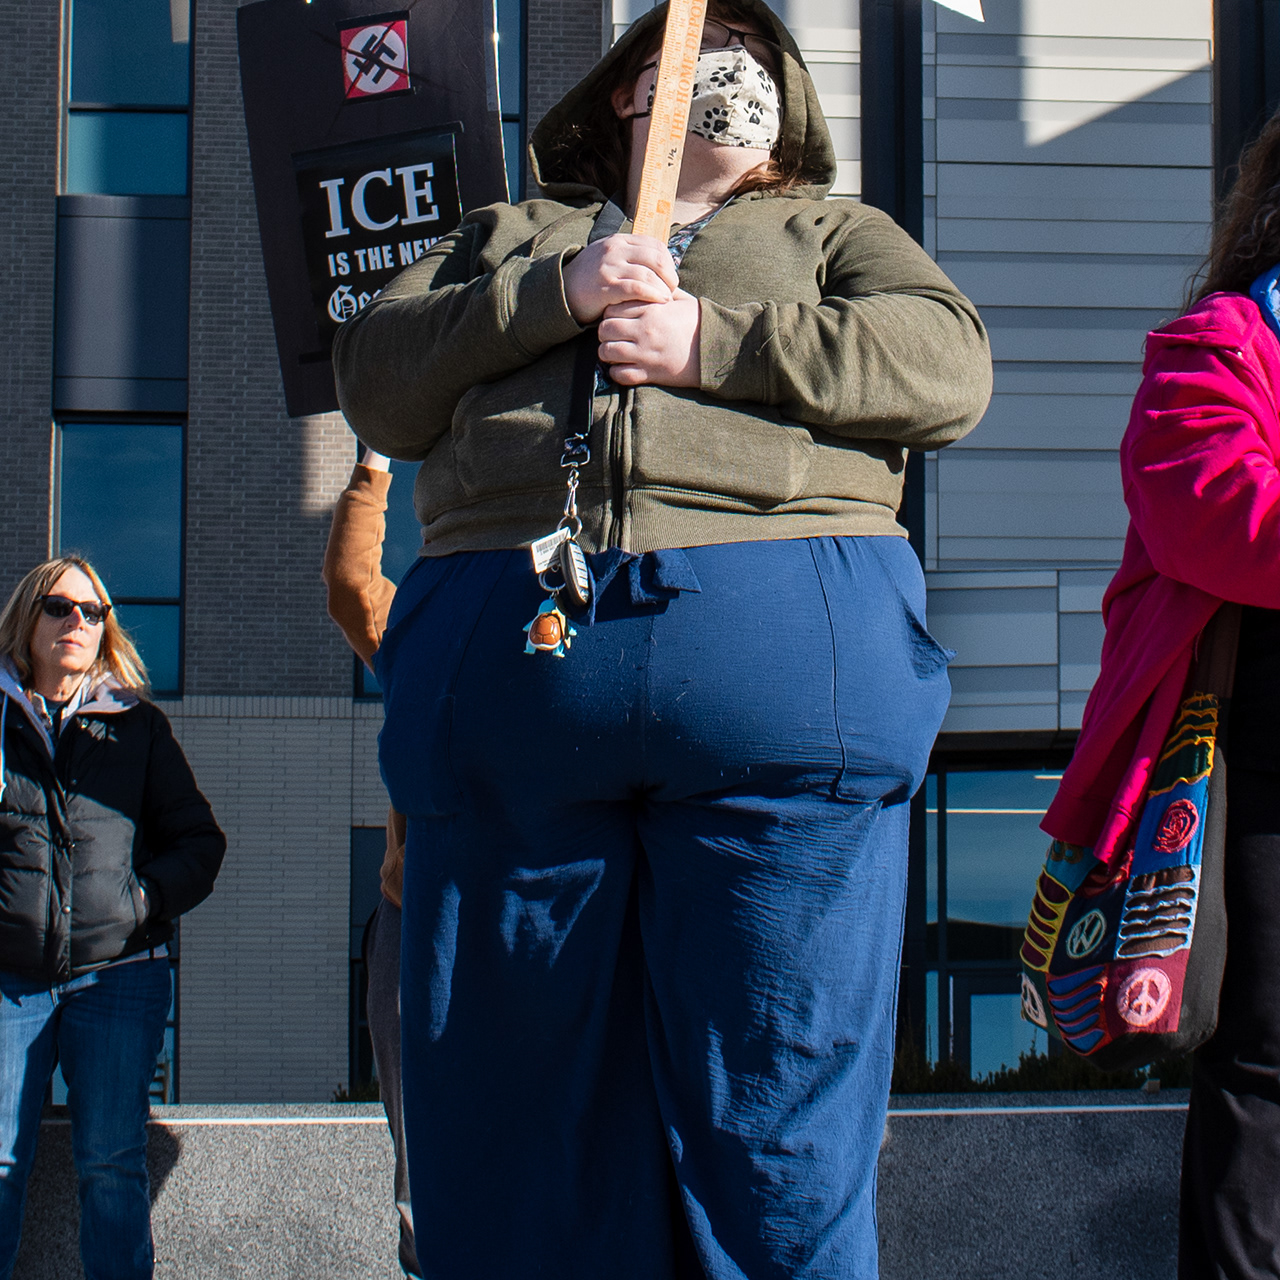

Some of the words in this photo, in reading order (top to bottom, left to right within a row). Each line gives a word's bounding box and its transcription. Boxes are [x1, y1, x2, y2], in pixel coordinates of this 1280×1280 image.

[675, 53, 695, 103] HOME
[669, 107, 686, 142] THE
[319, 162, 439, 238] ICE
[328, 252, 350, 277] IS
[354, 245, 394, 272] THE
